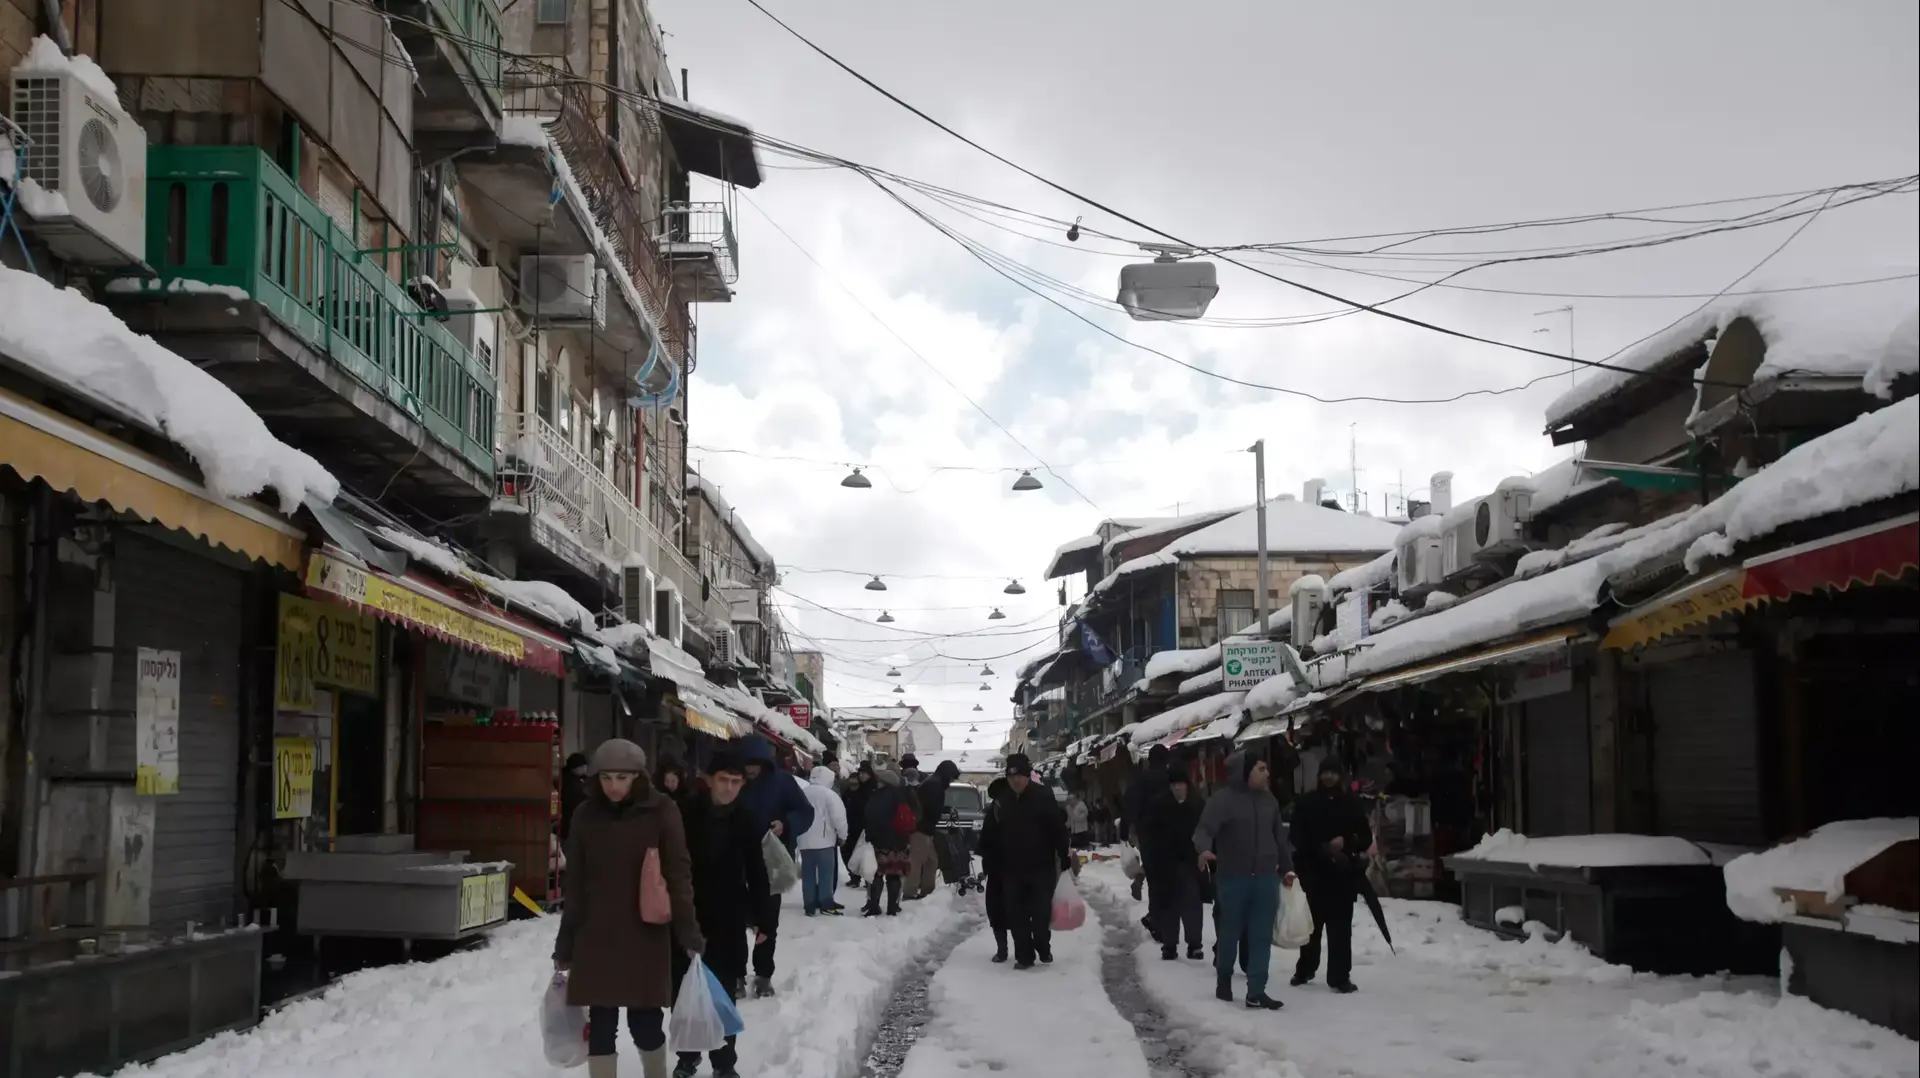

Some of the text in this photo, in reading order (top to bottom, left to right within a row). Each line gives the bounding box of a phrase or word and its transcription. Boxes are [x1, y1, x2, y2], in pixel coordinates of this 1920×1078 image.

[316, 614, 330, 677] 8
[1226, 646, 1276, 656] בית מרקחת
[1244, 668, 1277, 677] АПТЕКА
[1228, 679, 1265, 688] PHARM
[276, 748, 292, 813] 18
